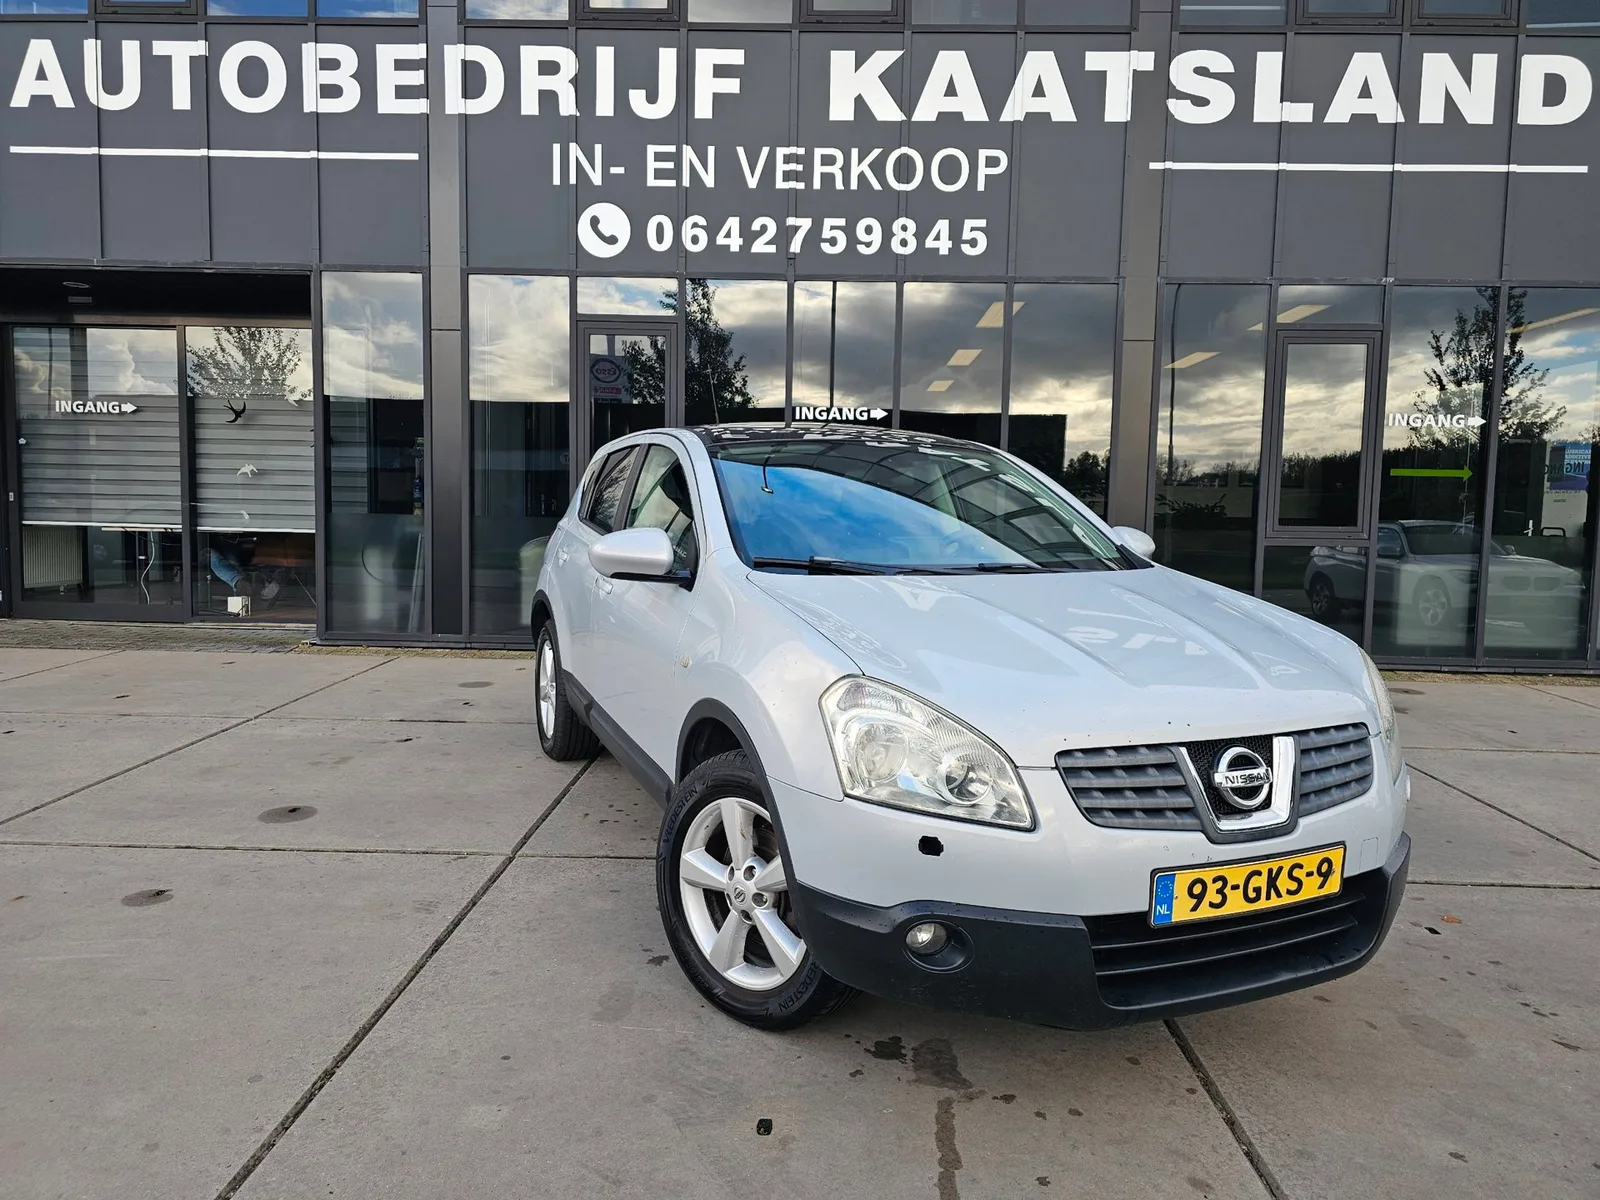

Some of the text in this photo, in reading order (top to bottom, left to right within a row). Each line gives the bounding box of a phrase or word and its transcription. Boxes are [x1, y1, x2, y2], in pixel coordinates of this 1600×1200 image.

[10, 38, 1593, 126] AUTOBEDRIJF KAATSLAND
[552, 142, 1008, 193] IN- EN VERKOOP
[646, 215, 988, 256] 0642759845
[55, 400, 120, 414] INGANG
[795, 406, 869, 421] INGANG
[1388, 412, 1465, 428] INGANG
[1224, 768, 1271, 785] NISSAN
[663, 785, 699, 843] VREDESTEIN
[1187, 856, 1334, 913] 93-GKS-9
[1156, 903, 1171, 916] NL
[778, 961, 821, 1012] REDESTEIN
